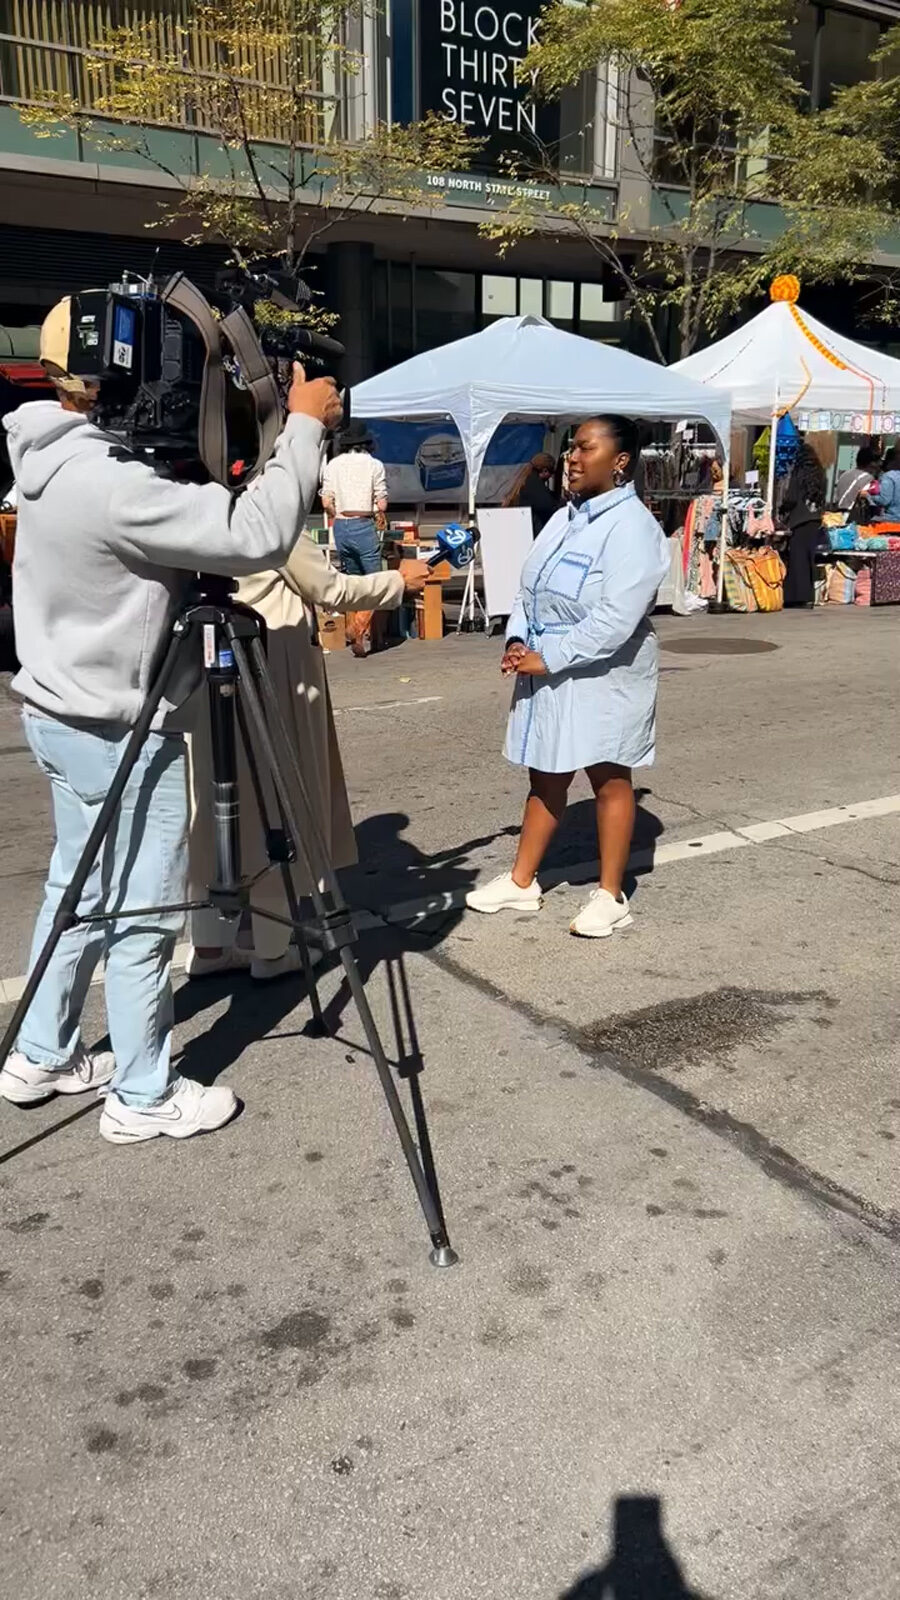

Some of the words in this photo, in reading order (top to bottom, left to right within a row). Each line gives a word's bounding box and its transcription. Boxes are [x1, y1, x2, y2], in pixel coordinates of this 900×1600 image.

[440, 0, 541, 47] BLOCK
[441, 43, 541, 90] THIRTY
[441, 88, 536, 134] SEVEN
[426, 175, 445, 187] 108
[448, 178, 482, 192] NORTH
[516, 188, 551, 200] STREET
